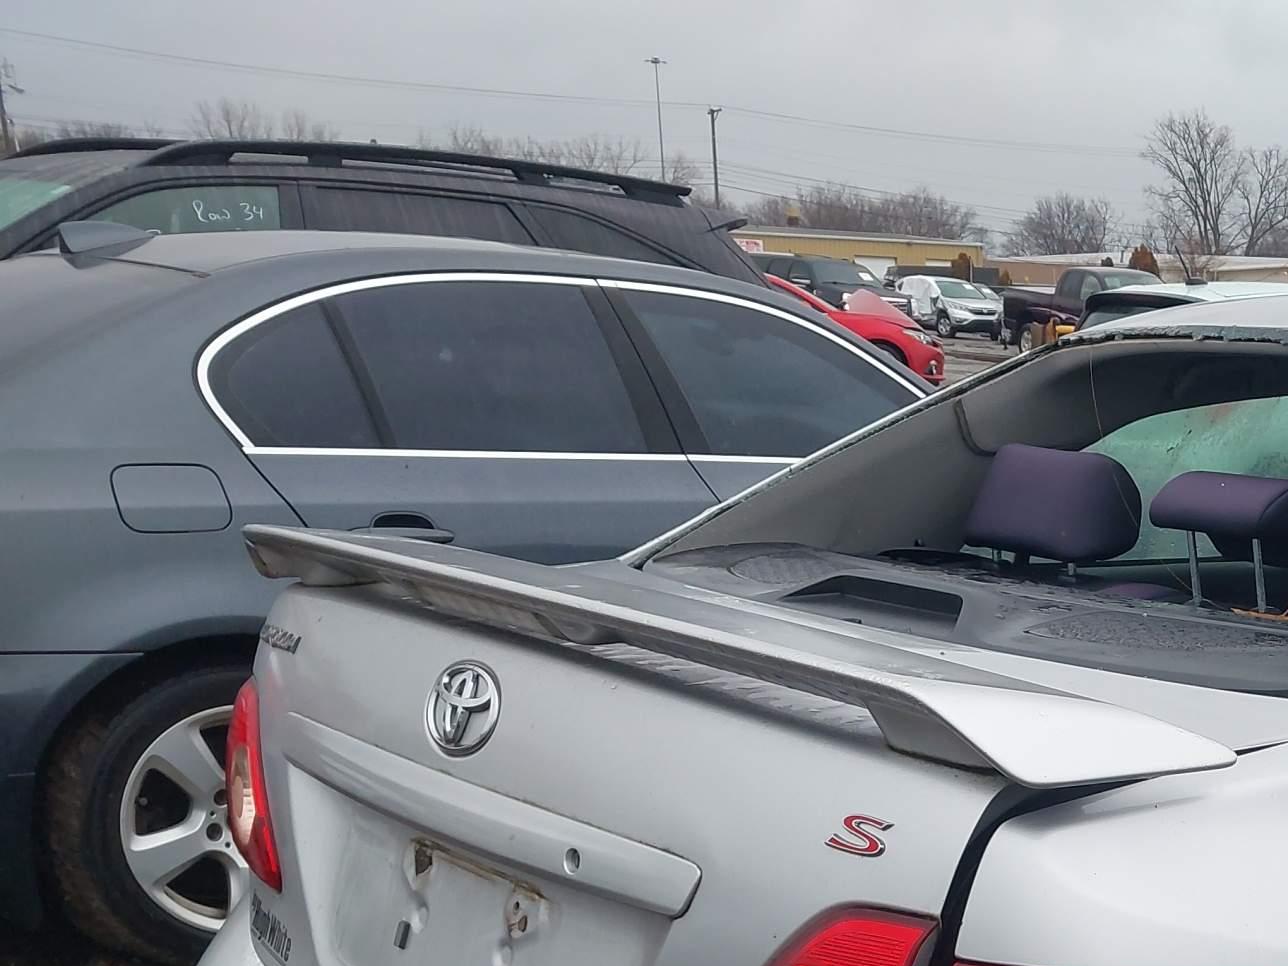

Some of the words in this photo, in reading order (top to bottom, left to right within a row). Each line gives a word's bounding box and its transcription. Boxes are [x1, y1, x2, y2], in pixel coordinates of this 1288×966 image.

[192, 199, 231, 223] Row
[240, 202, 264, 221] 34
[823, 814, 895, 858] S
